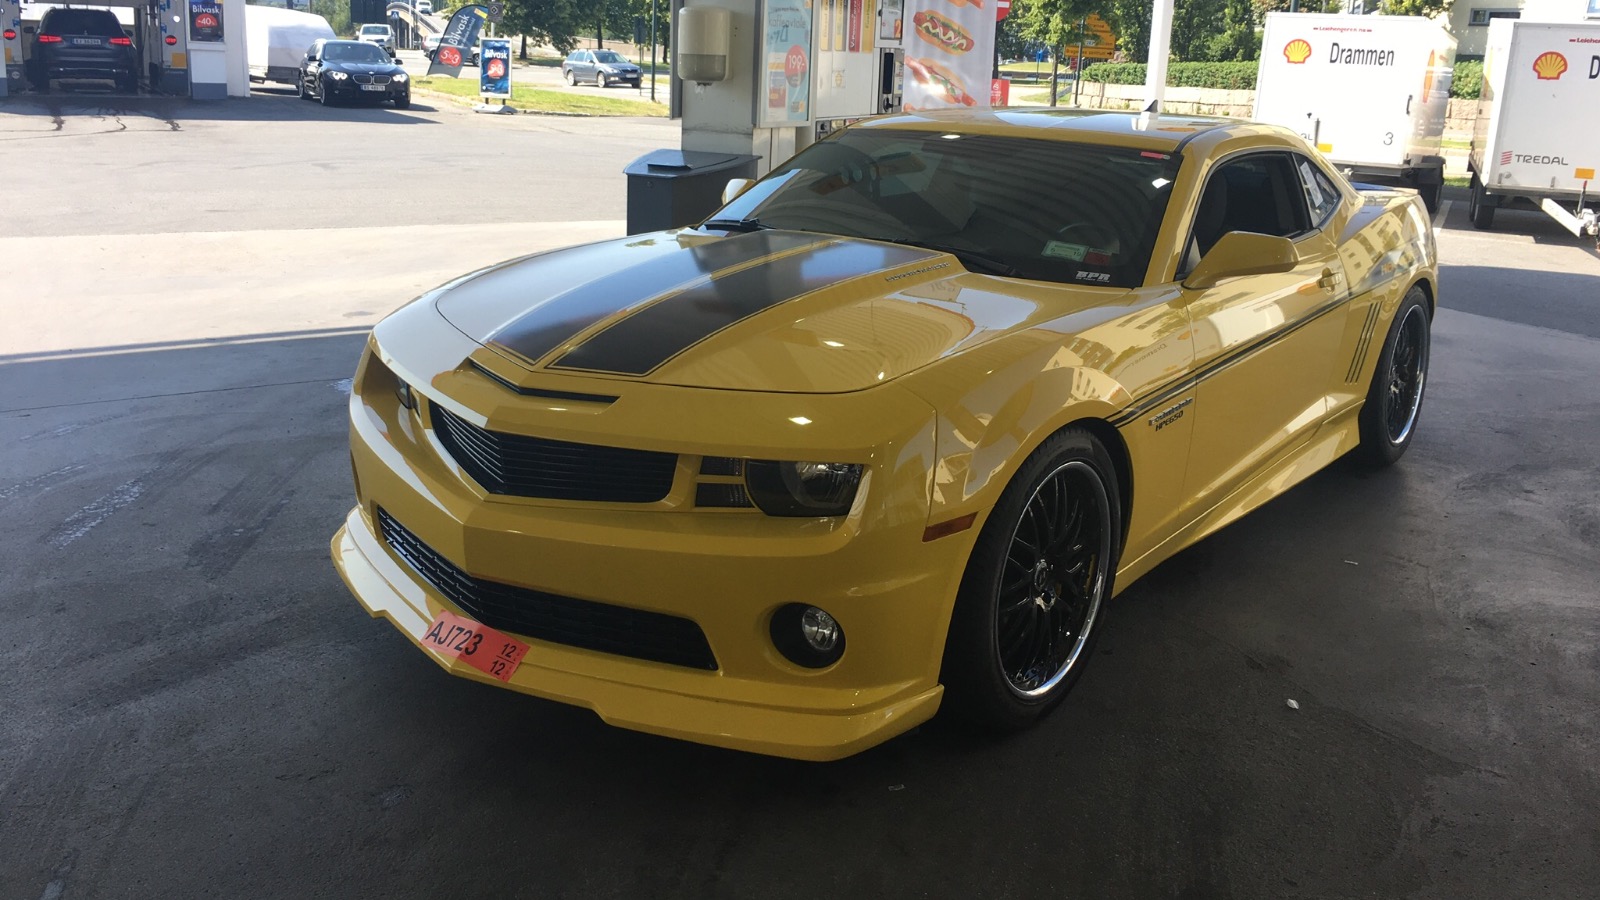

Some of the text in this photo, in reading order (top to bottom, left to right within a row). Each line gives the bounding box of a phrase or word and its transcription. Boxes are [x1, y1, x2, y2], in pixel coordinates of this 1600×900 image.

[192, 5, 220, 14] Bilvask
[448, 14, 470, 46] Bilvask
[441, 50, 450, 60] 5
[451, 54, 460, 64] 3
[484, 49, 508, 59] Bilvask
[1329, 42, 1395, 66] Drammen
[1383, 132, 1394, 146] 3
[1515, 154, 1569, 166] TREDAL
[1076, 271, 1111, 281] BPR
[425, 621, 484, 656] AJ723
[501, 643, 517, 658] 12
[490, 660, 506, 676] 12
